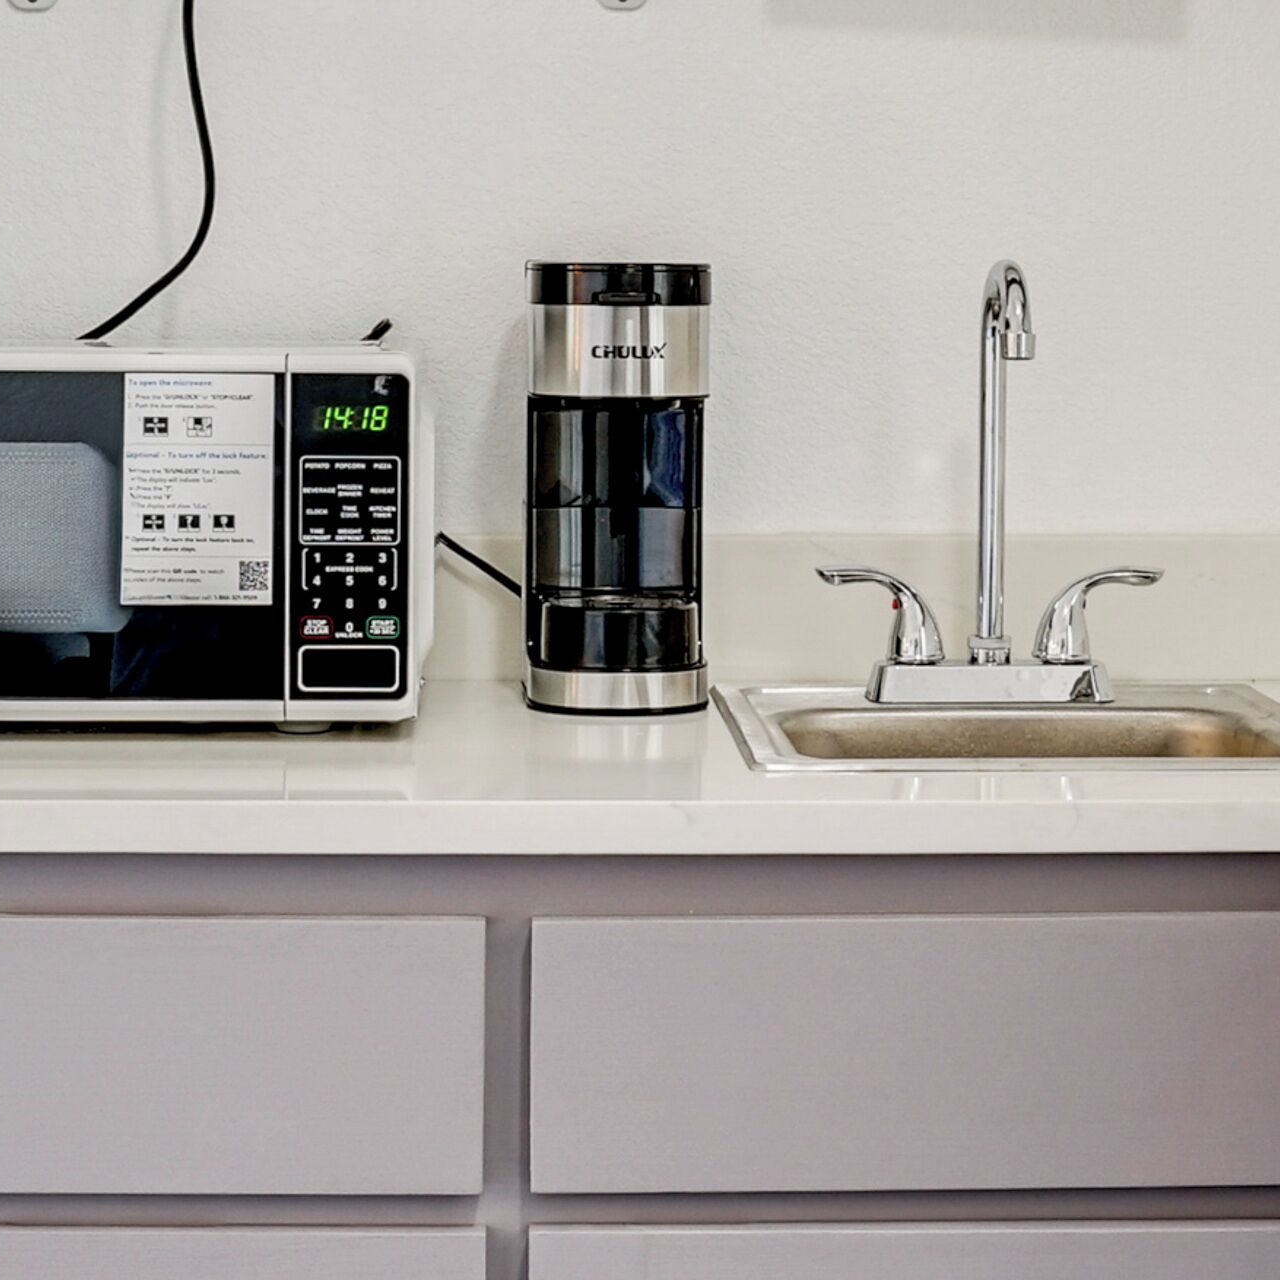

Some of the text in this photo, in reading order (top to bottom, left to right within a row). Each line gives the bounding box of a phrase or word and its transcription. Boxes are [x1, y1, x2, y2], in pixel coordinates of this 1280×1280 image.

[591, 341, 667, 359] CHULUX
[323, 405, 389, 431] 14:18
[313, 552, 321, 563] 1
[345, 553, 354, 563] 2
[378, 553, 387, 563] 3
[312, 575, 321, 586] 4
[345, 575, 354, 586] 5
[378, 575, 387, 586] 6
[312, 598, 321, 609] 7
[345, 598, 354, 609] 8
[378, 598, 387, 609] 9
[345, 622, 354, 632] 0
